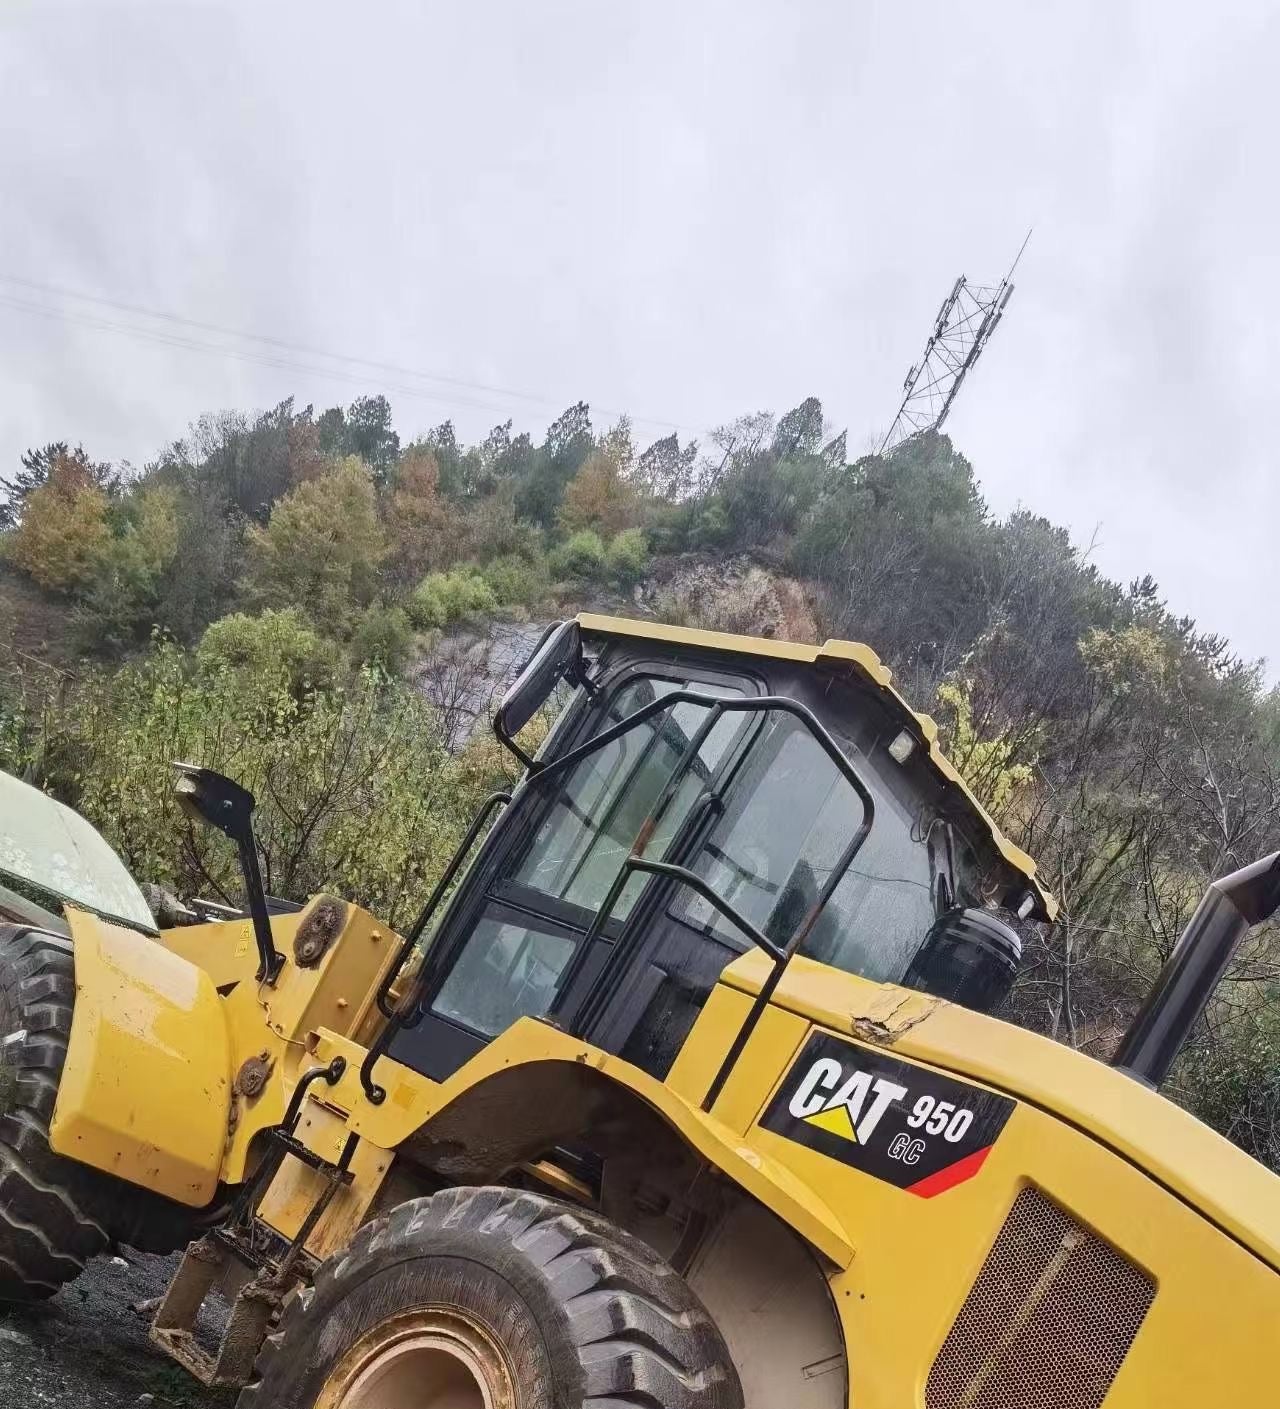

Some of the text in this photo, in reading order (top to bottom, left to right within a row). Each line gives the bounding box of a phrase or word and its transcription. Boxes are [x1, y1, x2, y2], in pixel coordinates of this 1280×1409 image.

[788, 1057, 974, 1146] CAT 950
[887, 1132, 926, 1165] GC
